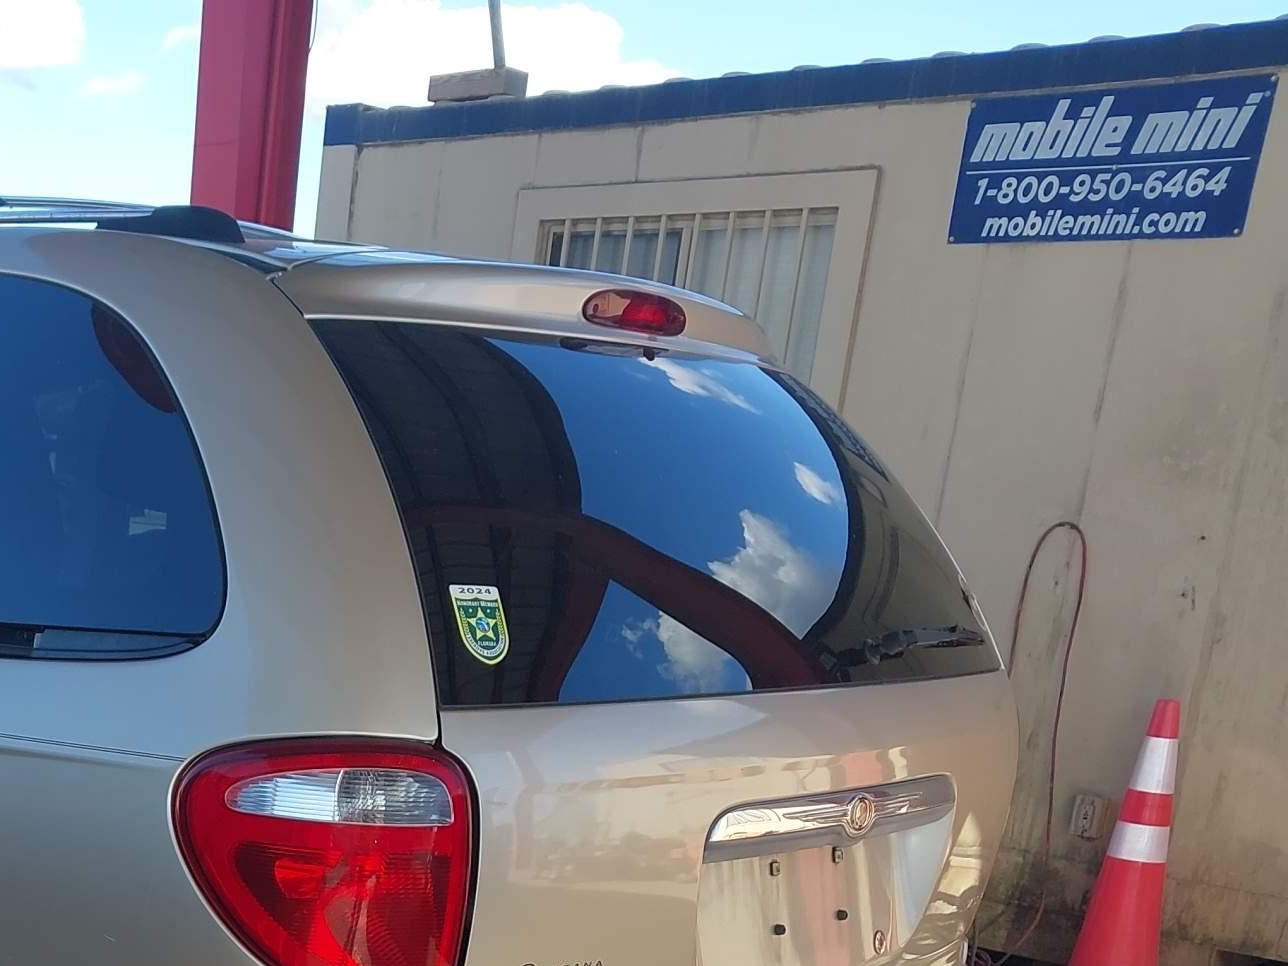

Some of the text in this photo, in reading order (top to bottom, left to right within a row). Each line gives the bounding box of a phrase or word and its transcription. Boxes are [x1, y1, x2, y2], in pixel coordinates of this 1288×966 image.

[969, 91, 1265, 163] mobile mini
[973, 166, 1232, 205] 1-800-950-6464
[981, 207, 1207, 237] mobilemini.com
[457, 587, 492, 595] 2024
